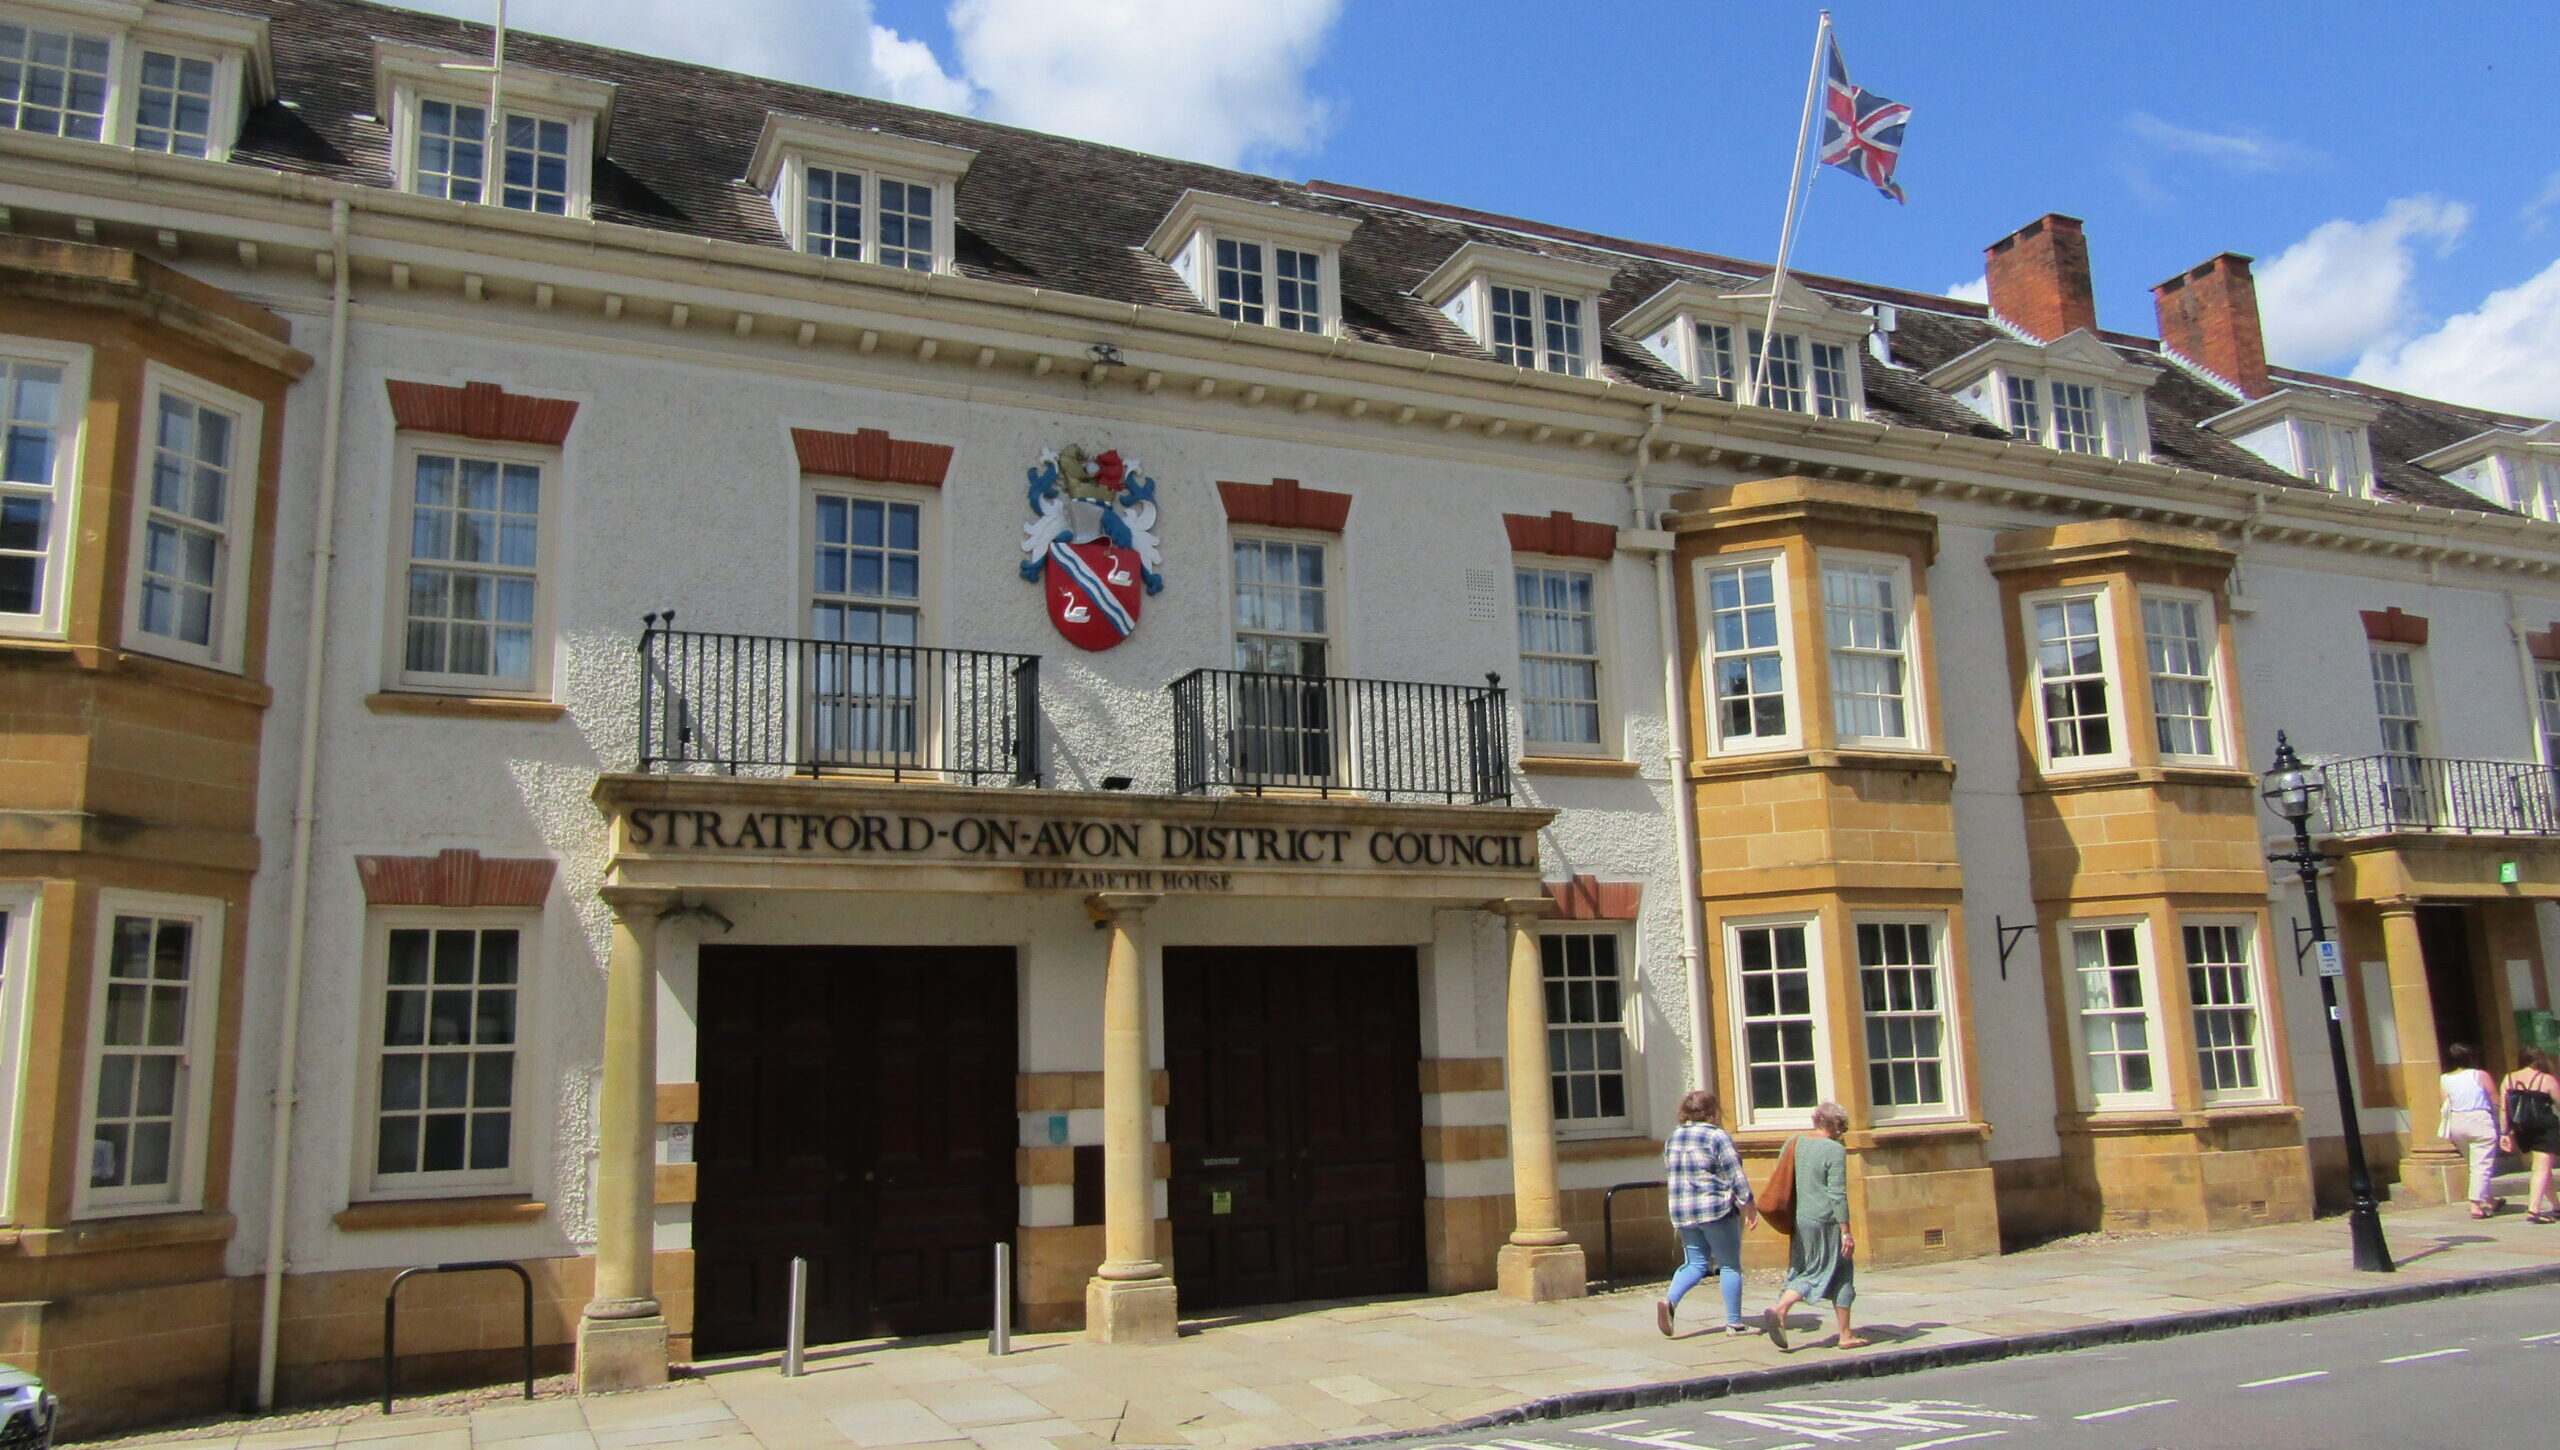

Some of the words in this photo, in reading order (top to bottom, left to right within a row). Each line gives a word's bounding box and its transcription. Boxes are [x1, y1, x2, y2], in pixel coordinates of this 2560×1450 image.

[629, 807, 1142, 858] STRATFORD-ON-AVON
[1161, 824, 1351, 863] DISTRICT
[1369, 830, 1535, 868] COUNCIL
[1024, 870, 1152, 890] ELIZABETH
[1162, 872, 1234, 890] HOUSE
[1410, 1399, 2037, 1450] EAR
